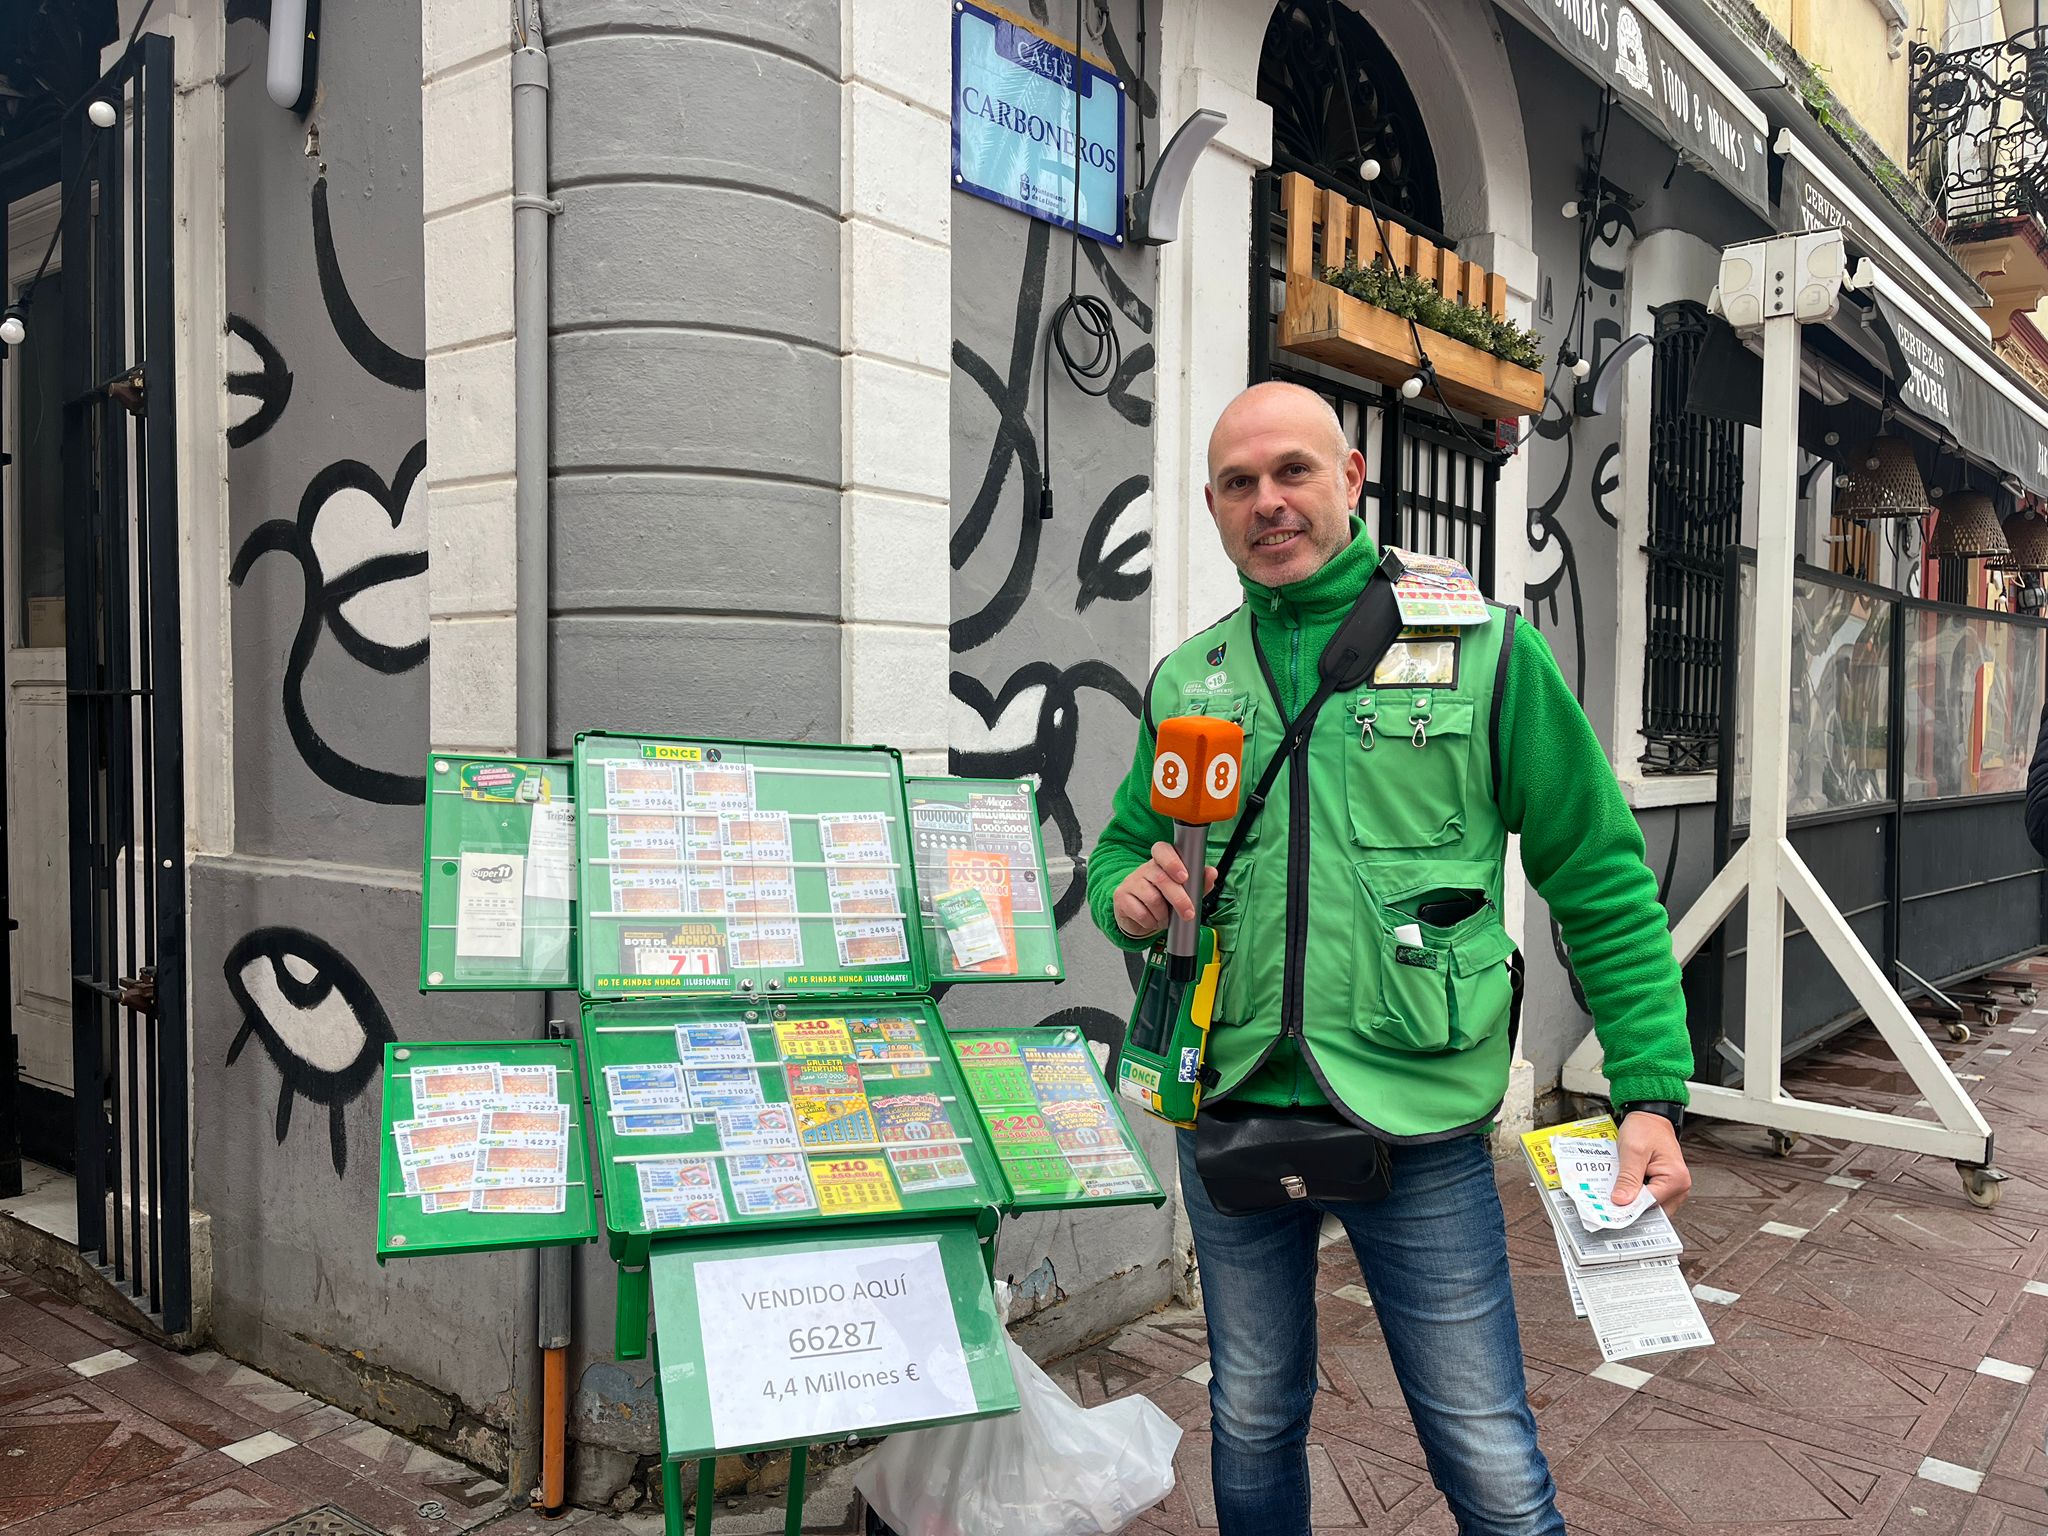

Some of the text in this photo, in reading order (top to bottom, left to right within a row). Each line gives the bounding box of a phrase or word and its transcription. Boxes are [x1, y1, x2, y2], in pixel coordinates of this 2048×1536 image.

[1555, 0, 1608, 51] MBAS
[1018, 42, 1073, 84] CALLE
[962, 87, 1116, 174] CARBONEROS
[1660, 59, 1689, 123] FOOD
[1693, 94, 1703, 133] &
[1707, 105, 1746, 172] DRINKS
[1897, 322, 1945, 378] CERVEZAS
[1904, 362, 1950, 418] CTORIA
[659, 748, 697, 759] ONCE
[1162, 760, 1180, 790] 8
[1215, 761, 1230, 791] 8
[870, 926, 896, 934] 24956
[597, 978, 609, 986] NO
[611, 978, 620, 986] TE
[623, 978, 652, 986] RINDAS
[654, 978, 681, 986] NUNCA
[788, 975, 798, 984] NO
[800, 975, 808, 983] TE
[810, 975, 837, 983] RINDAS
[839, 974, 863, 983] NUNCA
[1131, 1067, 1157, 1086] ONCE
[1575, 1162, 1611, 1172] 01807
[741, 1273, 908, 1312] VENDIDO AQUÍ
[788, 1320, 878, 1354] 66287
[762, 1362, 921, 1402] 4,4 Millones €
